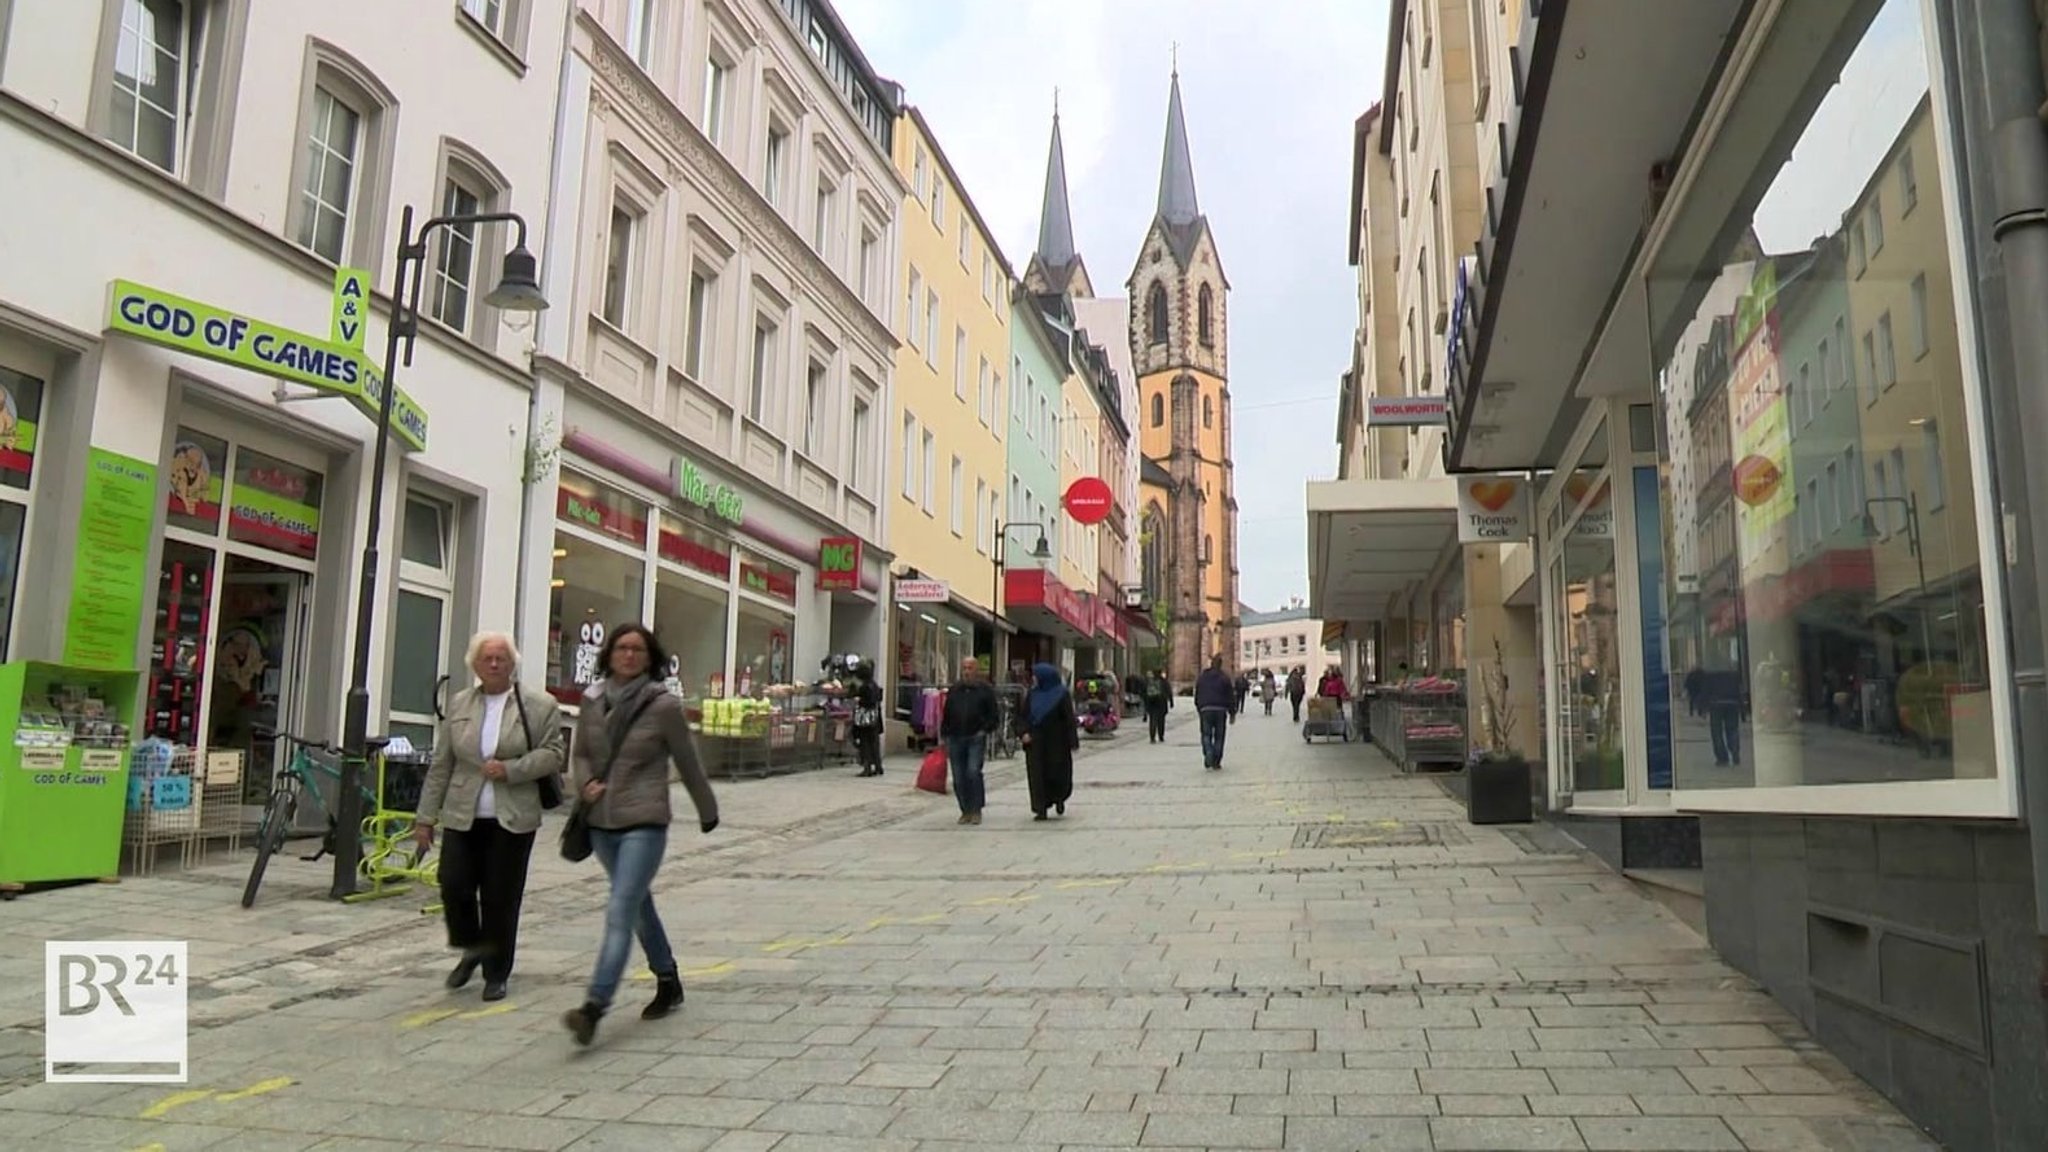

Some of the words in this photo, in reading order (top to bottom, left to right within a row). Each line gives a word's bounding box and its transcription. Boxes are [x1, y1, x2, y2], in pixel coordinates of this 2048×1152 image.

[120, 296, 195, 337] GOD
[204, 319, 248, 351] OF
[253, 335, 359, 385] GAMES
[1373, 403, 1444, 415] WOOLWORTH
[398, 402, 426, 443] GAMES
[235, 504, 260, 521] GOD
[262, 510, 275, 526] OF
[277, 516, 312, 535] GAMES
[1469, 514, 1518, 526] Thomas
[1477, 528, 1509, 538] Cook
[822, 544, 855, 571] MG
[34, 774, 56, 784] GOD
[162, 783, 174, 792] 50
